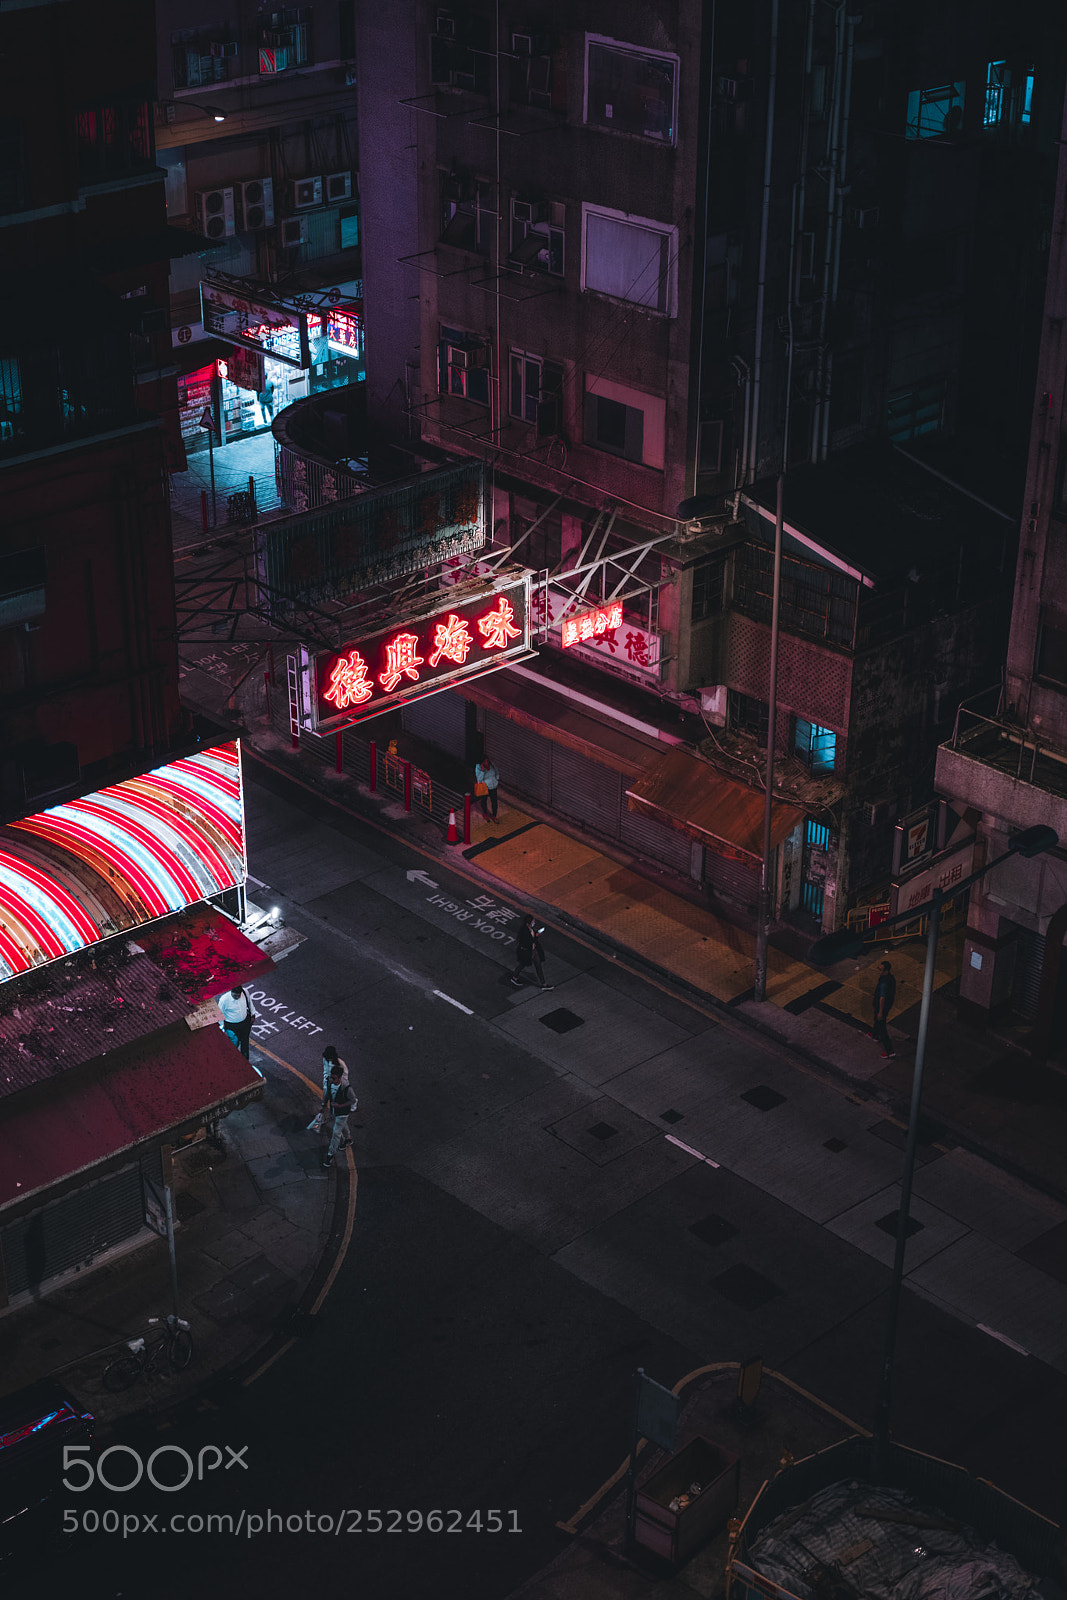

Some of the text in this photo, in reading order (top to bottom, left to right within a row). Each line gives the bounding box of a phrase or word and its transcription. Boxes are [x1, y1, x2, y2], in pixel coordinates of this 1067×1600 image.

[323, 597, 523, 710] 德興海味
[939, 864, 963, 889] 出租
[426, 894, 516, 946] LOOK RIGHT
[466, 895, 521, 925] 望右
[243, 984, 289, 1014] LOOK
[279, 1011, 324, 1036] LEFT
